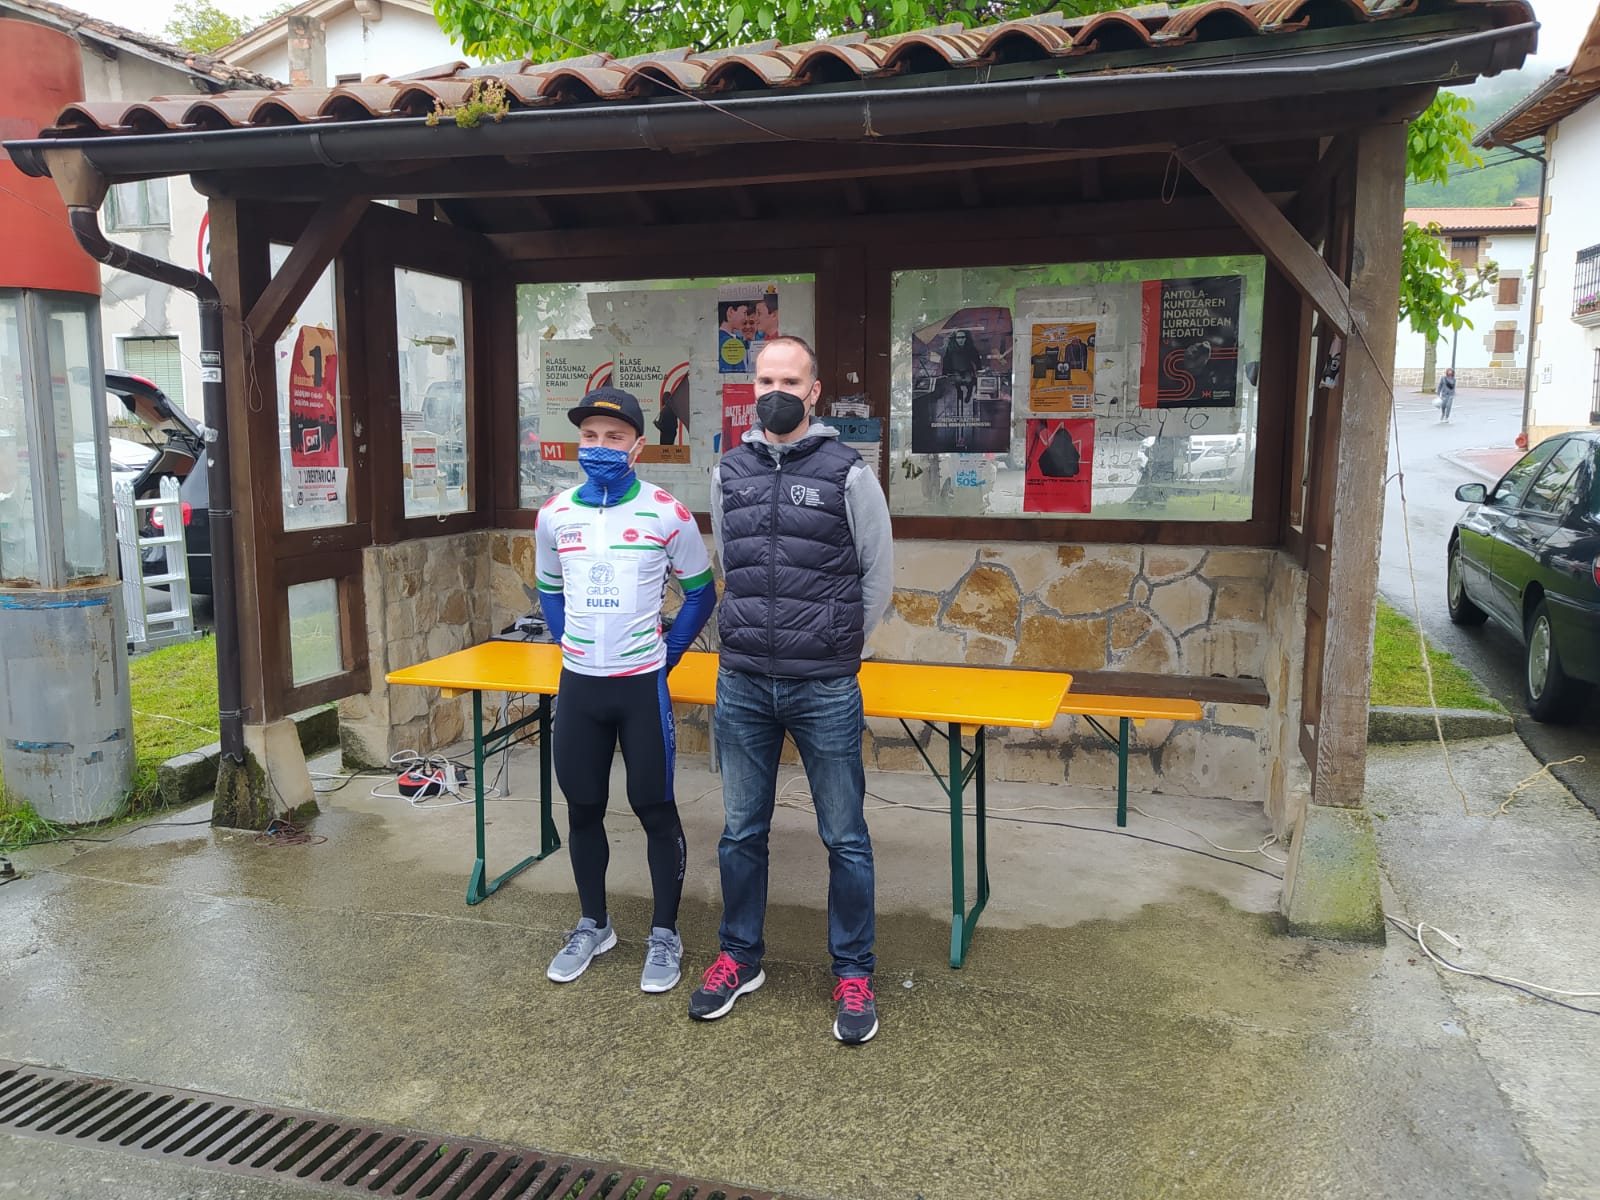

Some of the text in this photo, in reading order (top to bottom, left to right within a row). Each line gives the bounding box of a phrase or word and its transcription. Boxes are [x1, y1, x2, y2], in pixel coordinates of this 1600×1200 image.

[1163, 289, 1209, 300] ANTOLA-
[1163, 298, 1226, 309] KUNTZAREN
[1163, 309, 1210, 319] INDARRA
[1162, 318, 1232, 328] LURRALDEAN
[1162, 328, 1204, 338] HEDATU
[308, 345, 323, 387] 1
[619, 358, 642, 366] KLASE
[619, 373, 668, 381] SOZIALISMOA
[543, 445, 563, 459] M1
[586, 586, 620, 596] GRUPO
[586, 598, 620, 608] EULEN
